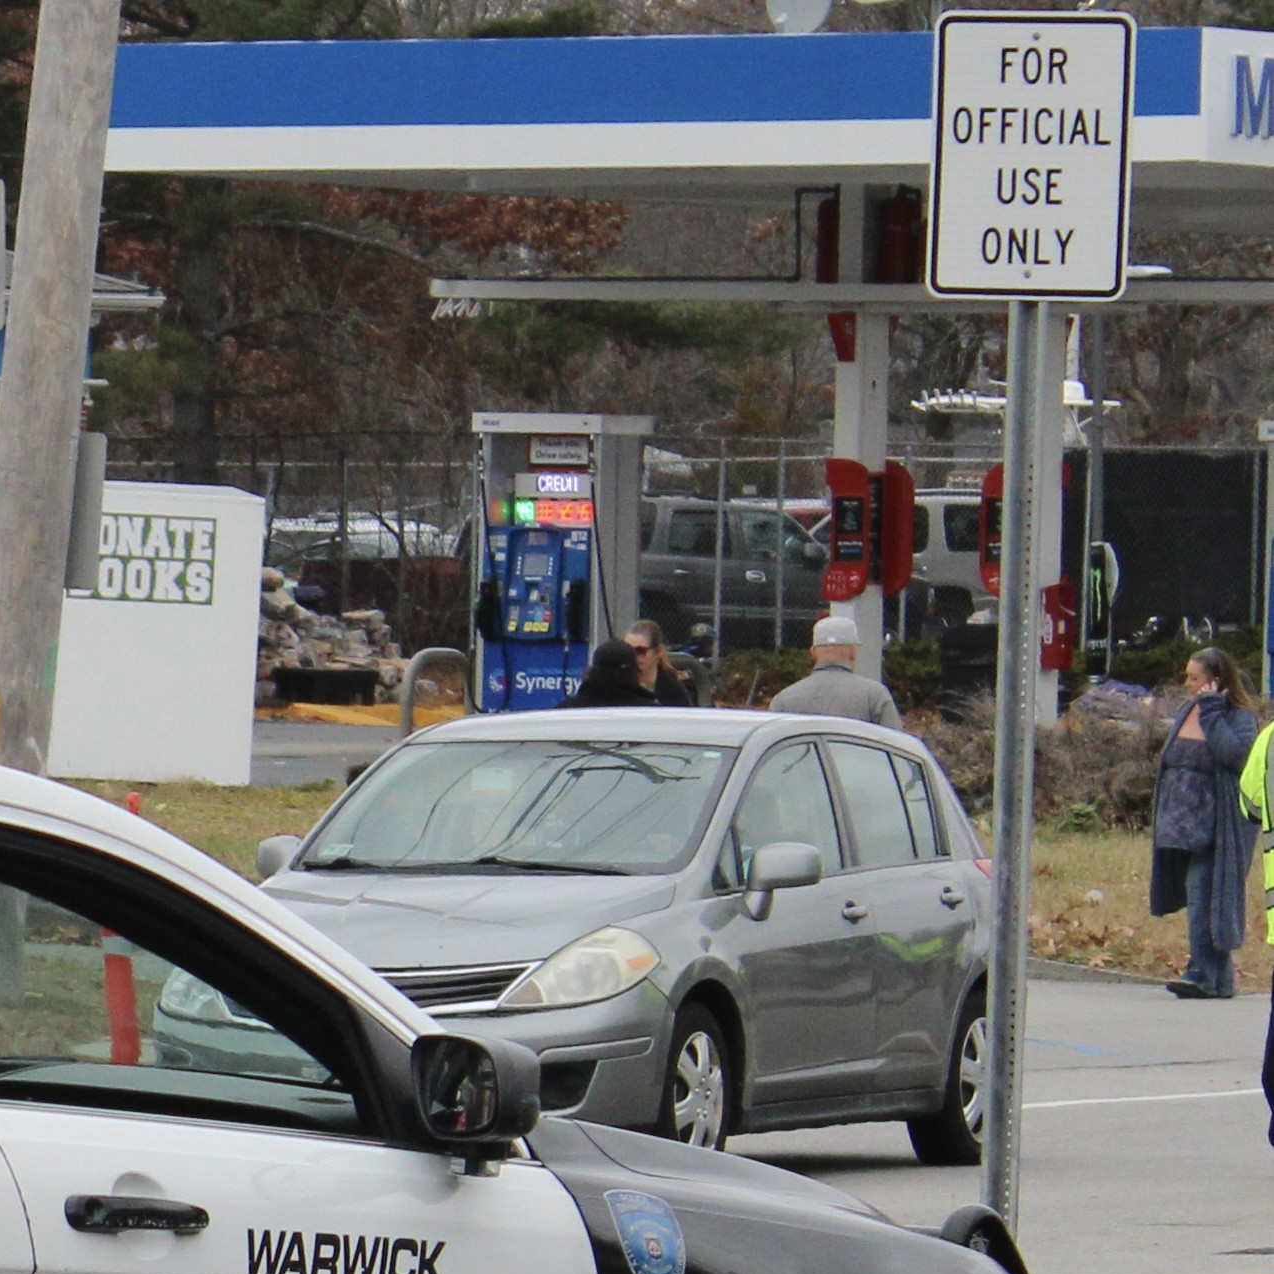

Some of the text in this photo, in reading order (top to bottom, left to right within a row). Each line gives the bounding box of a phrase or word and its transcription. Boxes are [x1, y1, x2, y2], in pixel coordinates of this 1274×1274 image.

[1000, 47, 1068, 85] FOR
[953, 106, 1112, 146] OFFICIAL
[996, 167, 1063, 205] USE
[980, 226, 1075, 265] ONLY
[99, 514, 215, 561] ONATE
[69, 556, 212, 604] OOKS
[515, 671, 583, 697] Synergy
